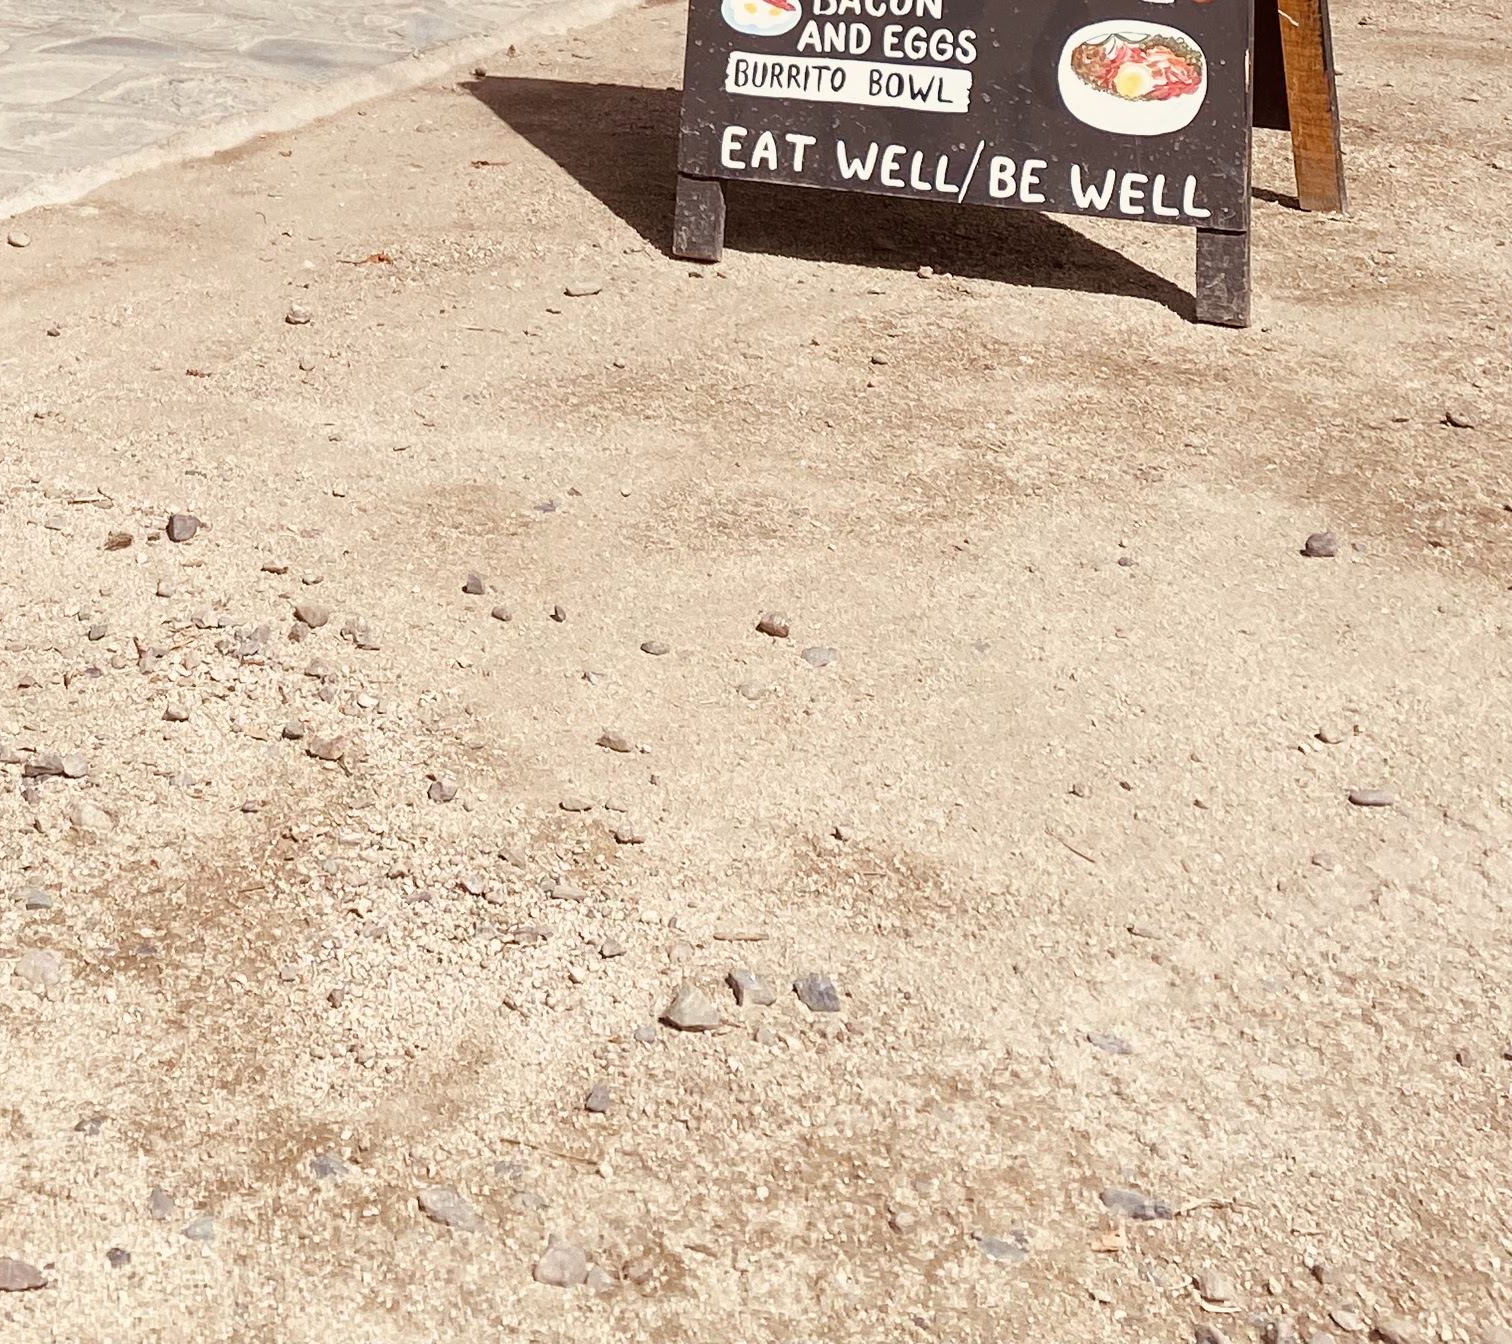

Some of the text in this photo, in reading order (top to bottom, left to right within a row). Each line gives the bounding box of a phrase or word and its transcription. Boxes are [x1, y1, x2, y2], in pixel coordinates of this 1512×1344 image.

[797, 21, 978, 64] AND EGGS
[734, 59, 953, 104] BURRITO BOWL
[721, 126, 816, 172] EAT
[1071, 165, 1211, 218] WELL
